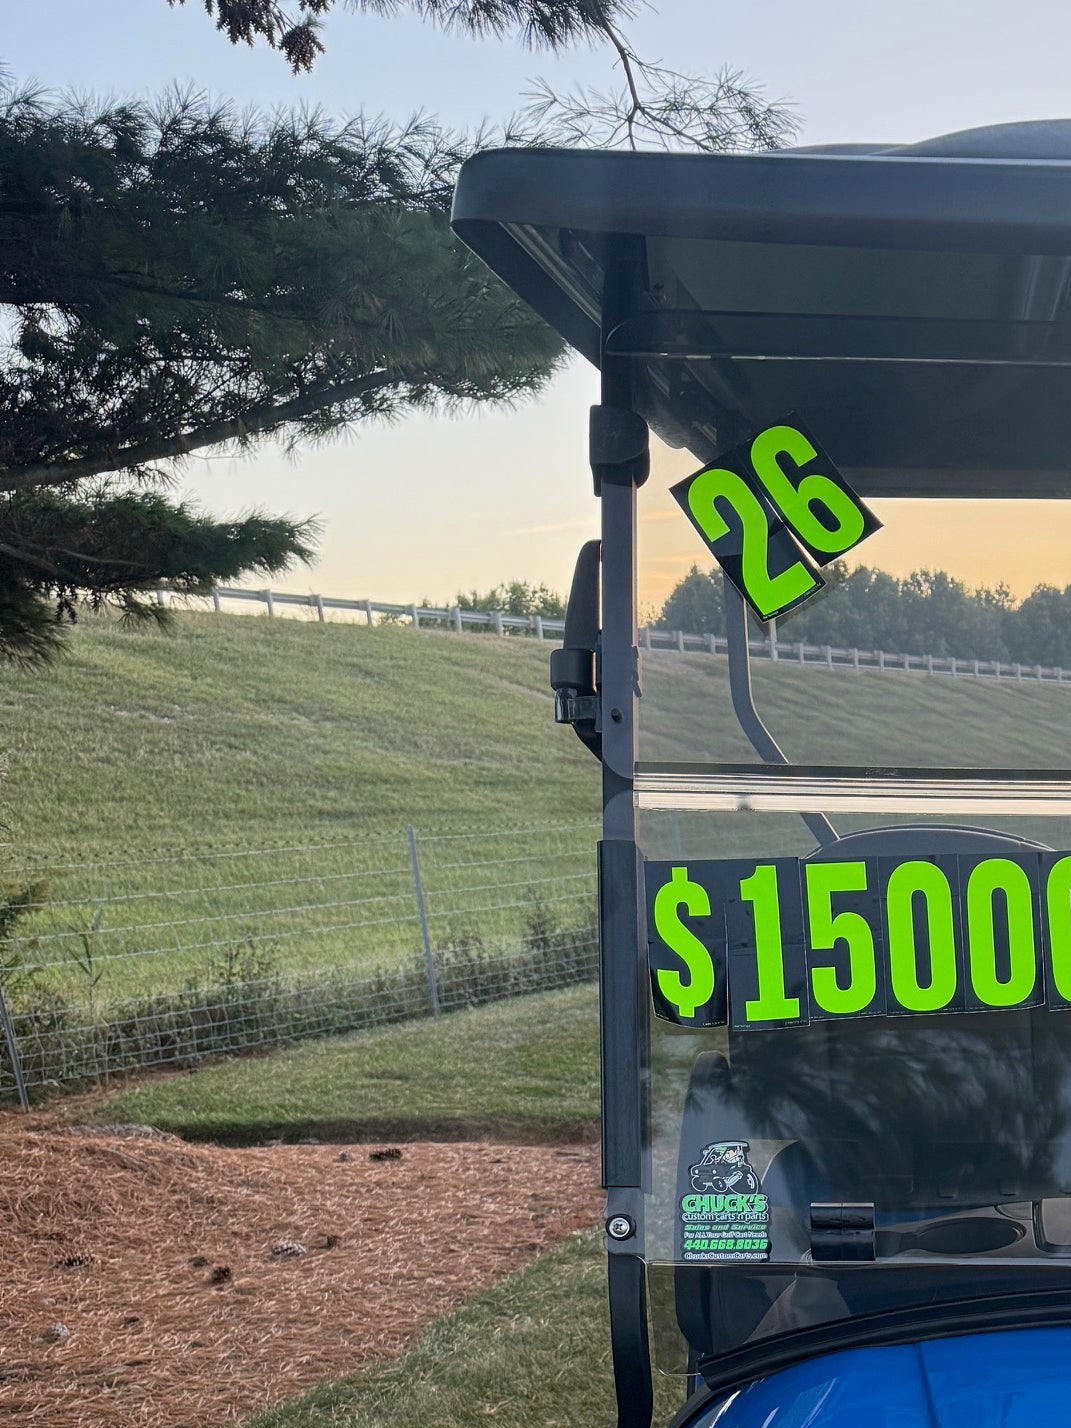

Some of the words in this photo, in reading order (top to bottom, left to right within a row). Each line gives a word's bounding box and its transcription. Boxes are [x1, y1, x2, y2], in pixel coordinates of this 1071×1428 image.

[687, 424, 865, 617] 26
[682, 1193, 768, 1213] CHUCK'S
[682, 1212, 714, 1221] custom
[715, 1212, 736, 1221] carts
[745, 1212, 766, 1222] parts
